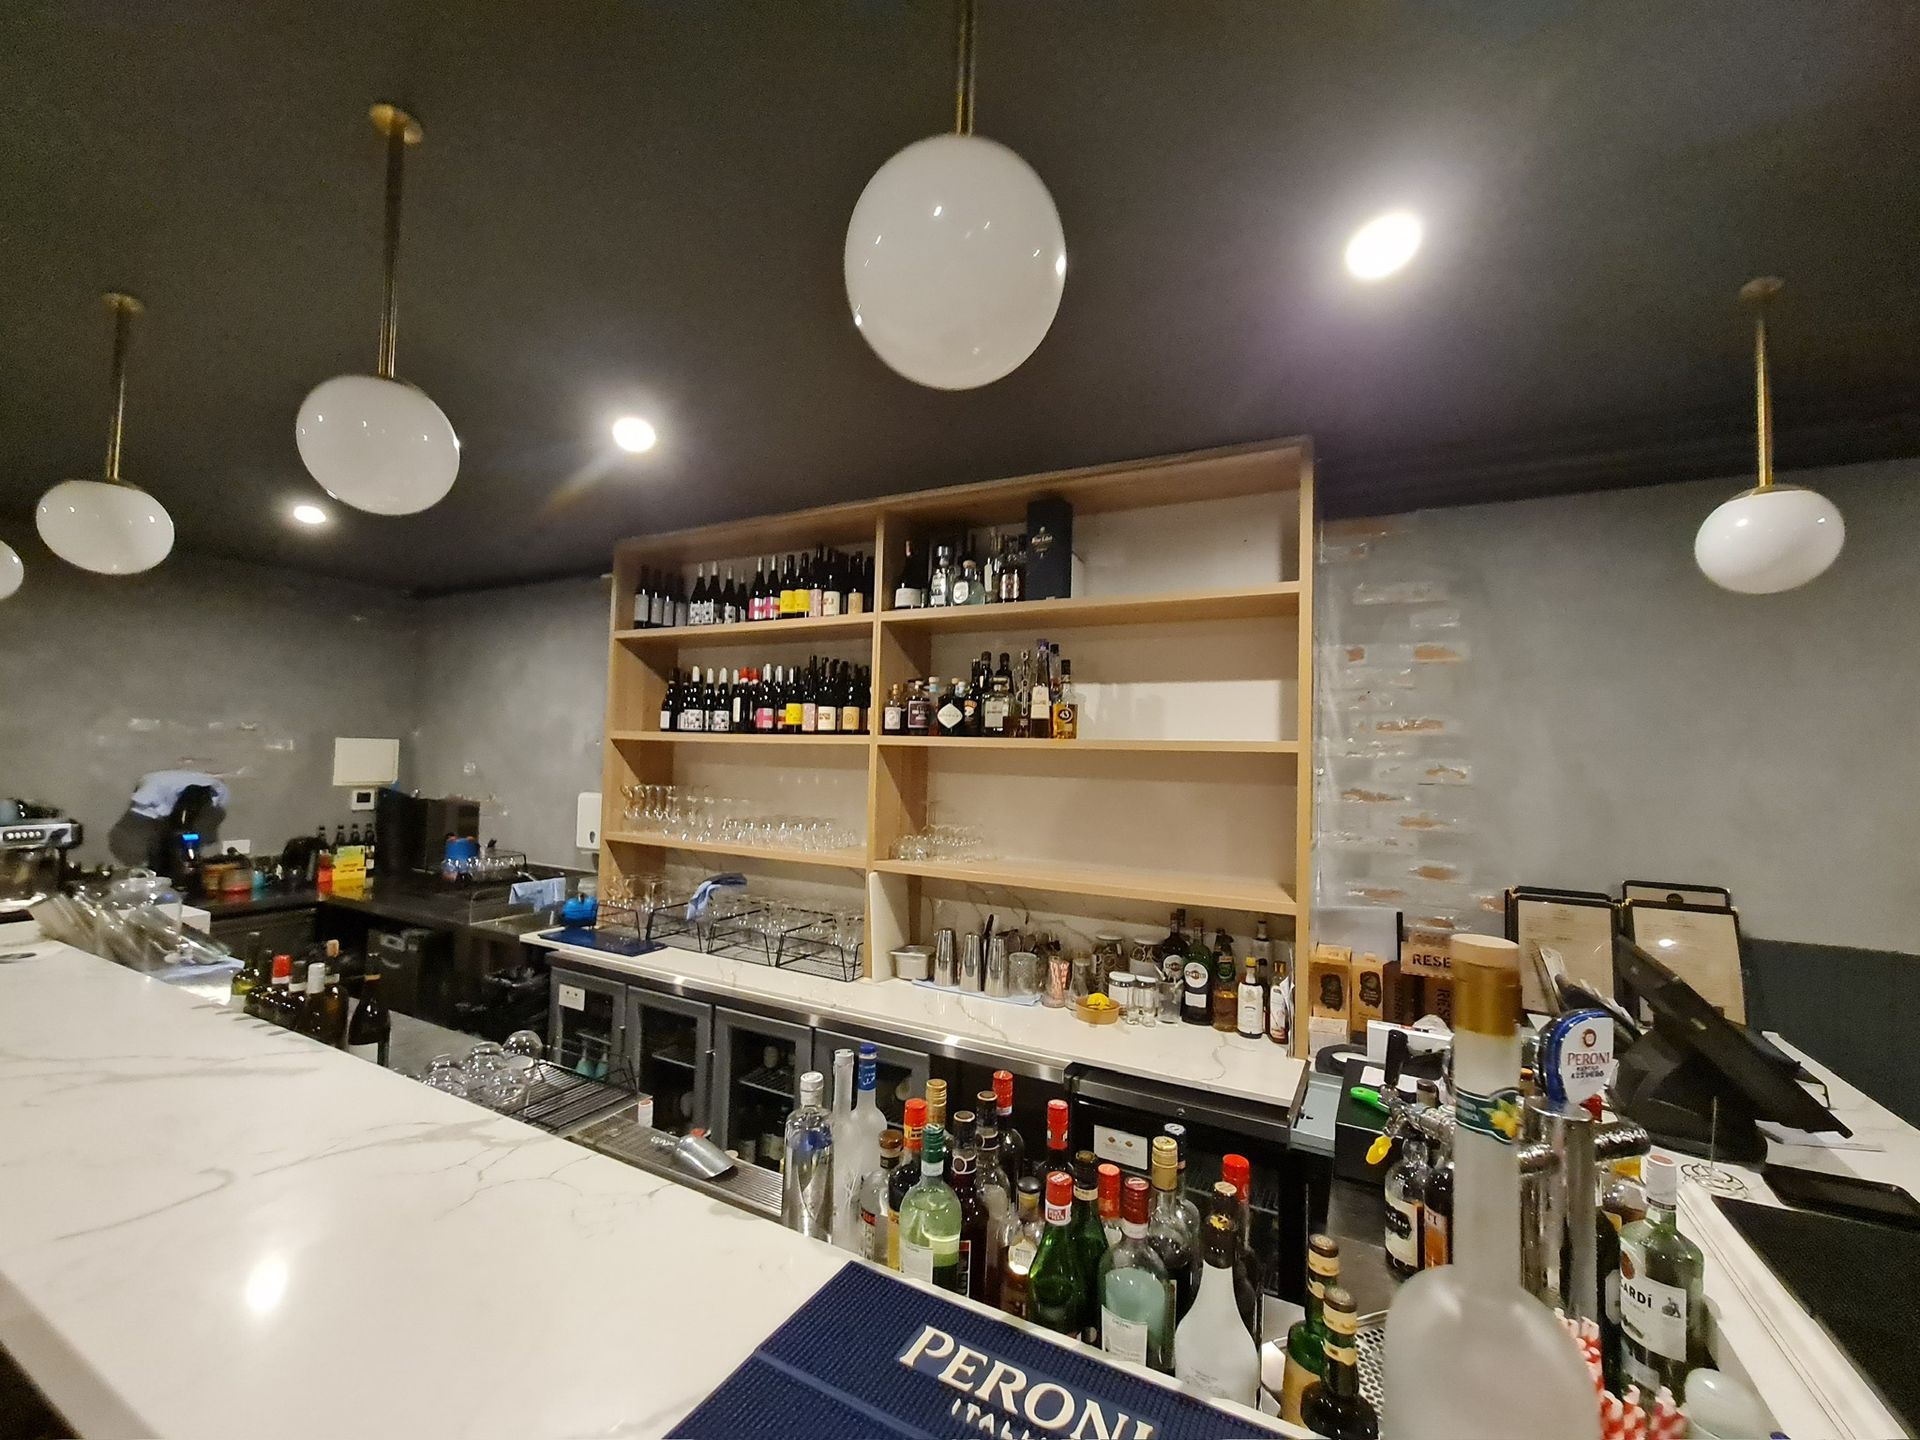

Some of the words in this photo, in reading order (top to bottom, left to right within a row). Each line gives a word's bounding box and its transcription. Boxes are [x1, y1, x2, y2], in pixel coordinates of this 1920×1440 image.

[1412, 953, 1451, 969] RESE
[1567, 1052, 1610, 1066] PERONI
[1621, 1282, 1652, 1309] ARDÍ
[951, 1398, 1048, 1440] ITALI
